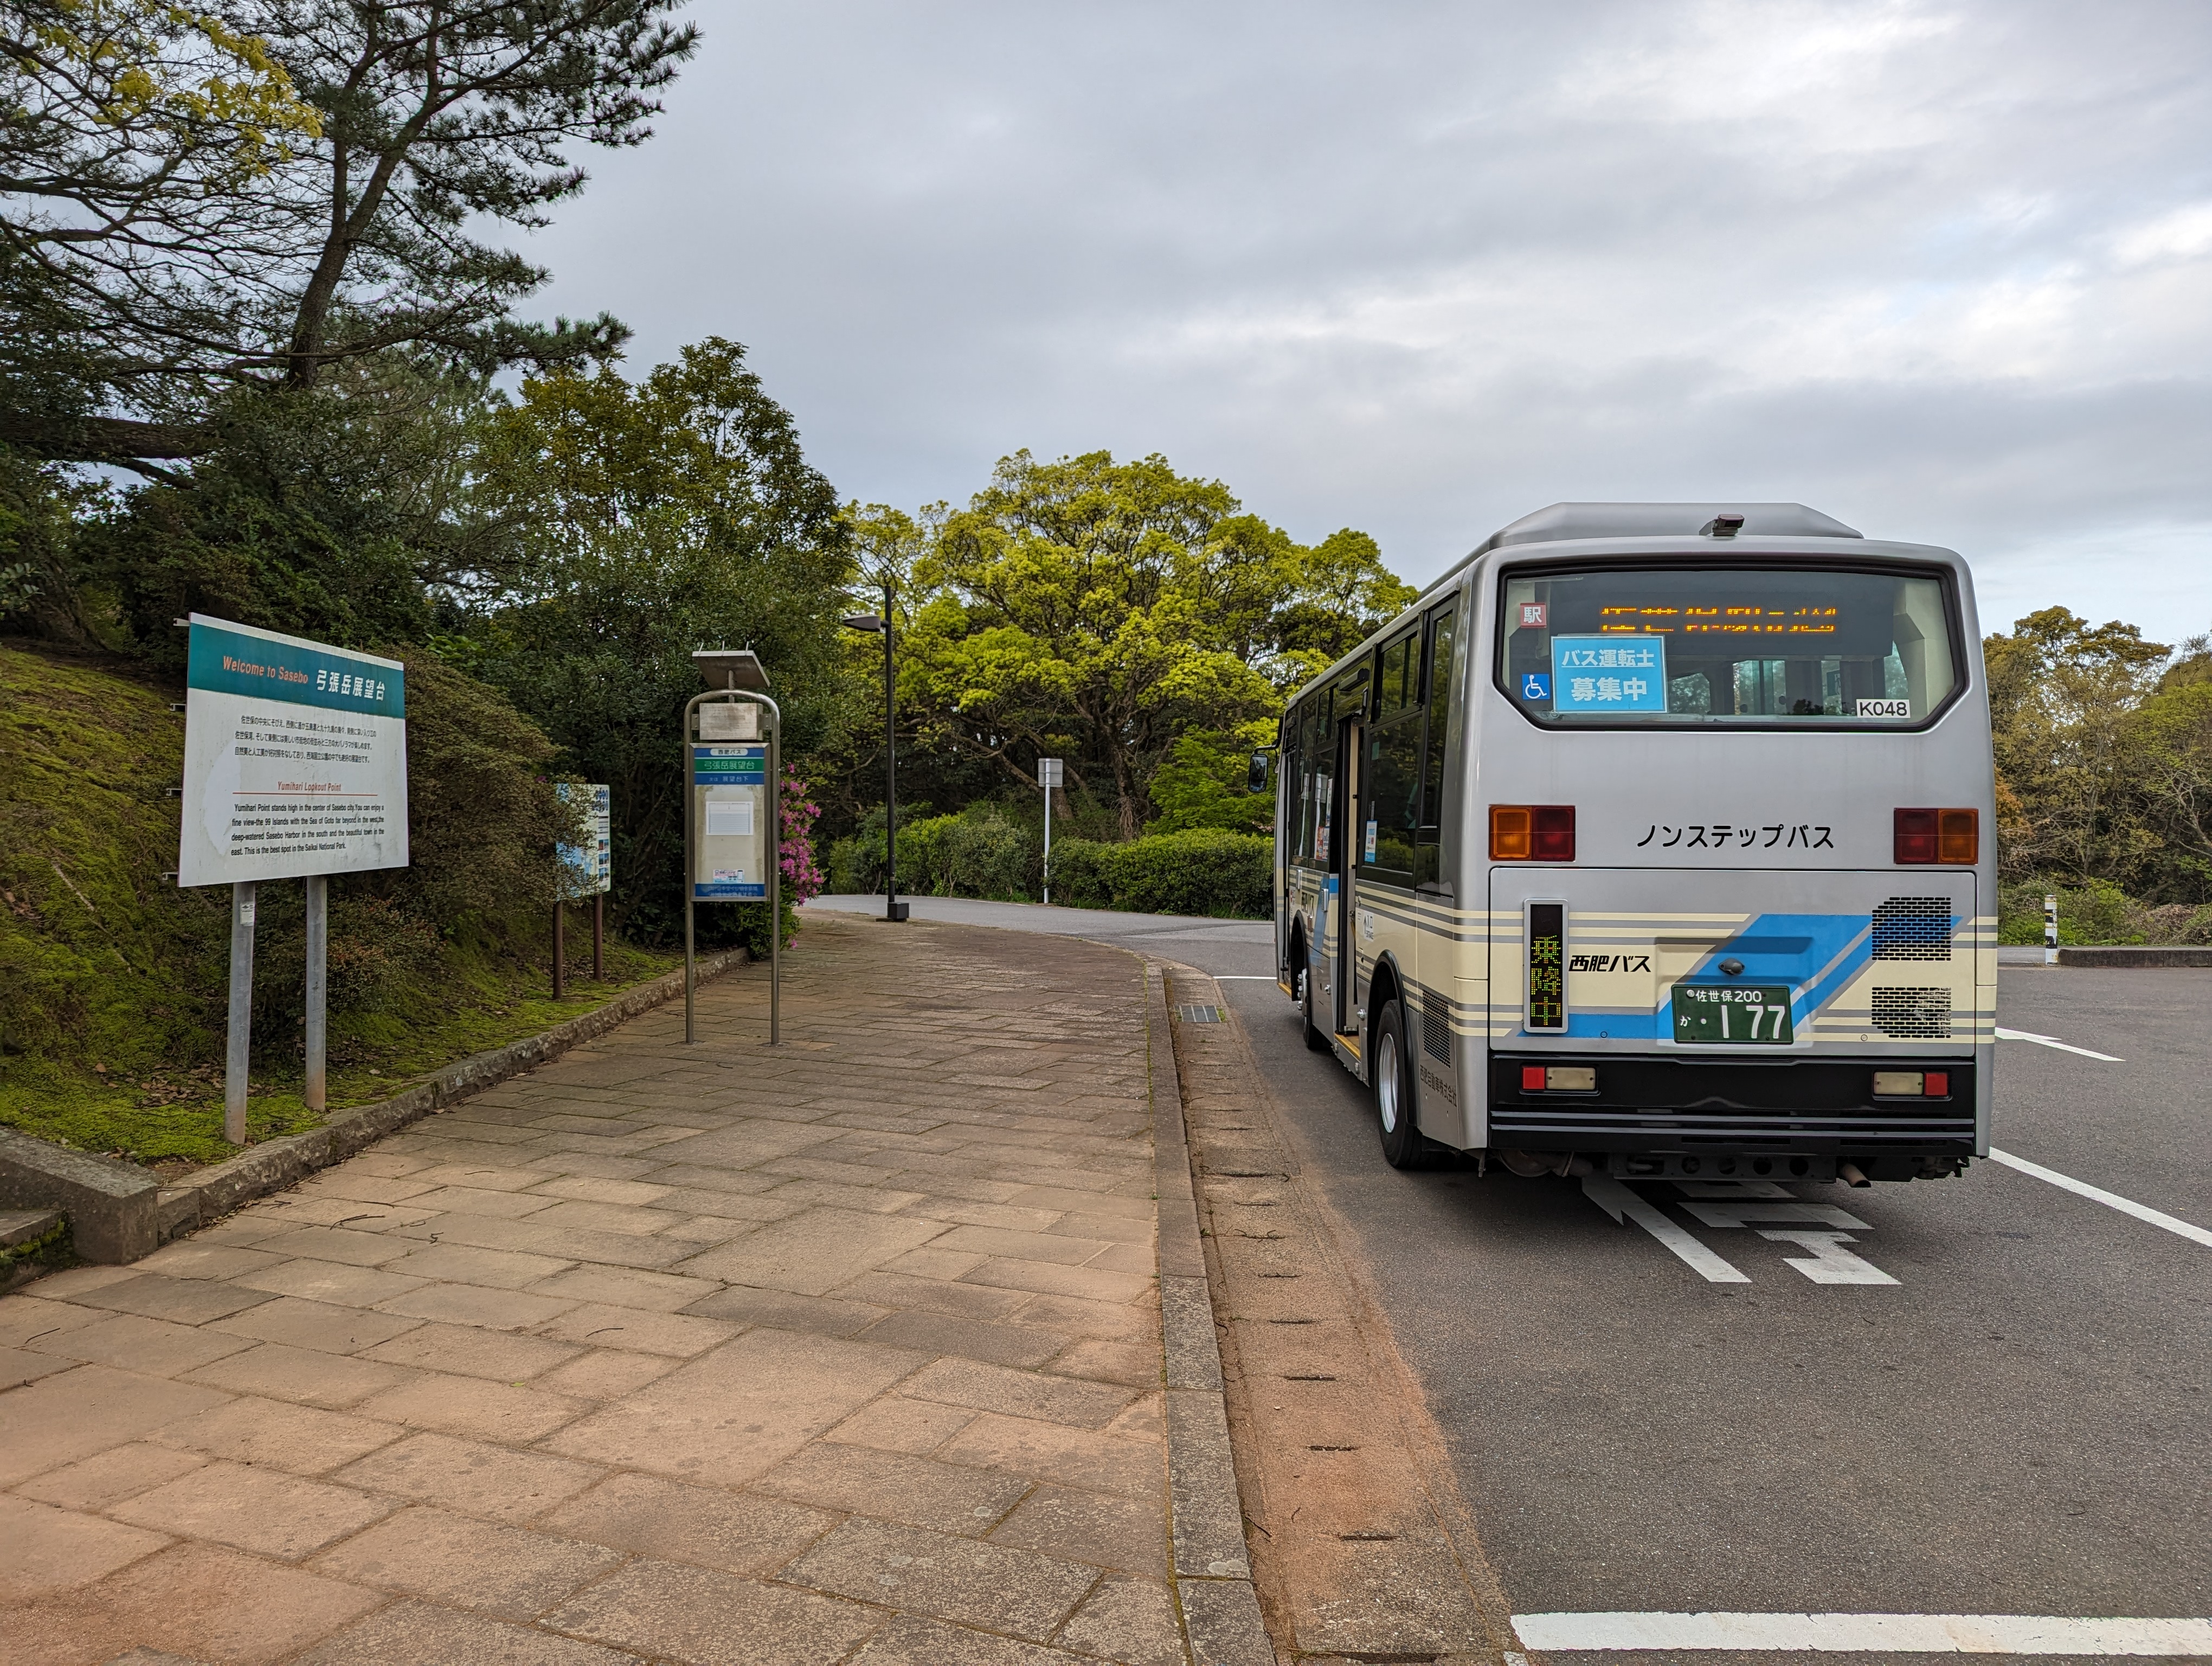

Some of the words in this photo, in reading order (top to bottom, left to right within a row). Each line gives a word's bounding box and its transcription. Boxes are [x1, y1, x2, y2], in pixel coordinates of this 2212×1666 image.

[1523, 606, 1542, 624] 駅
[1561, 649, 1655, 667] バス運転士
[223, 655, 265, 676] Welcome
[267, 665, 276, 678] to
[278, 666, 309, 684] Sasebo
[316, 669, 385, 701] 弓張岳展望台
[1571, 677, 1647, 701] 募集中
[1859, 701, 1907, 716] K048
[704, 760, 755, 770] 弓張岳展望台
[278, 781, 303, 791] Yumihari
[304, 782, 326, 791] Lookout
[328, 783, 342, 791] Point
[234, 804, 256, 812] Yumihari
[288, 804, 298, 813] high
[371, 804, 381, 812] enjoy
[232, 818, 242, 826] fine
[309, 817, 318, 825] Sea
[342, 816, 357, 825] beyond
[231, 832, 265, 843] deep-watered
[266, 831, 284, 840] Sasebo
[1637, 823, 1834, 848] ノンステップバス
[244, 847, 255, 855] This
[255, 846, 260, 854] is
[270, 845, 280, 854] best
[281, 845, 291, 855] spot
[305, 843, 318, 851] Saikai
[318, 842, 336, 850] National
[1568, 955, 1651, 972] 西肥バス
[1531, 934, 1561, 1026] 乗降中
[1680, 1015, 1692, 1027] か
